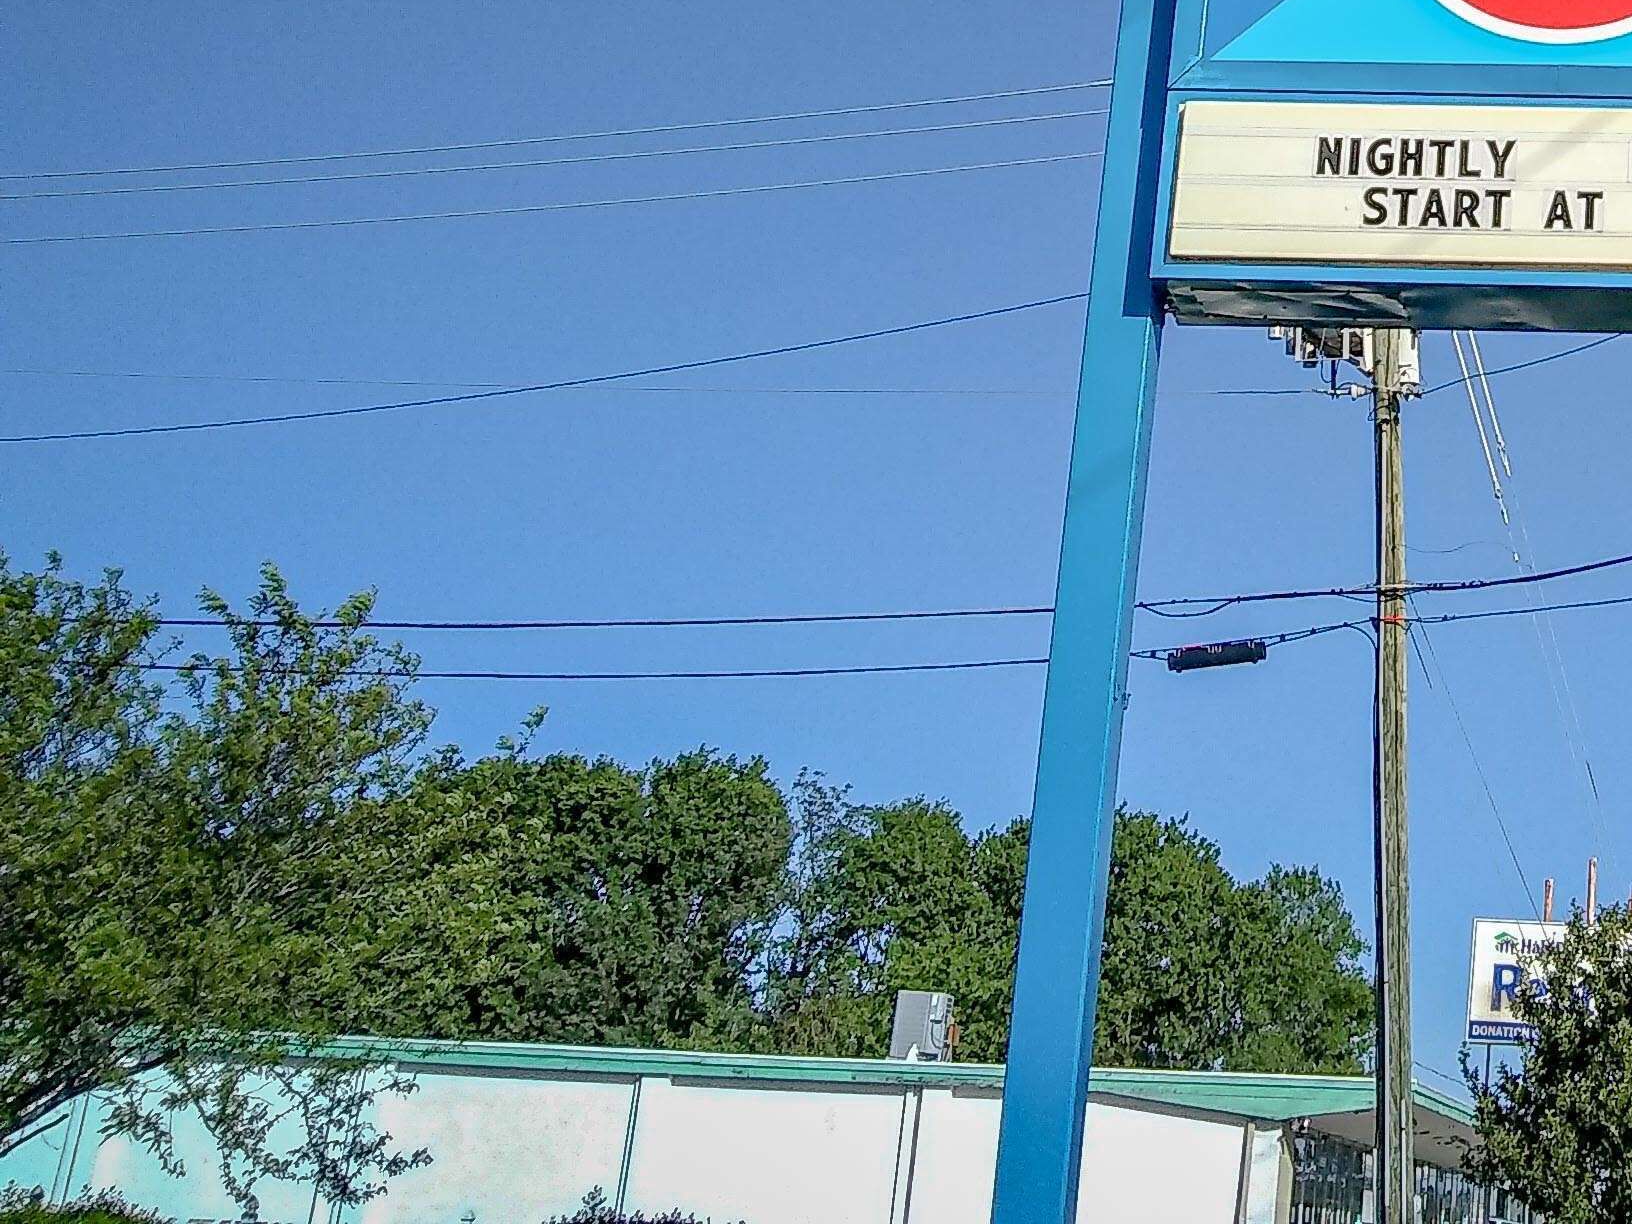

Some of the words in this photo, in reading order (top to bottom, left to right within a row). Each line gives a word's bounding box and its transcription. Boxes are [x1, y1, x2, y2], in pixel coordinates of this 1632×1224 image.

[1315, 136, 1517, 179] NIGHTLY
[1362, 187, 1511, 229] START
[1544, 189, 1604, 231] AT
